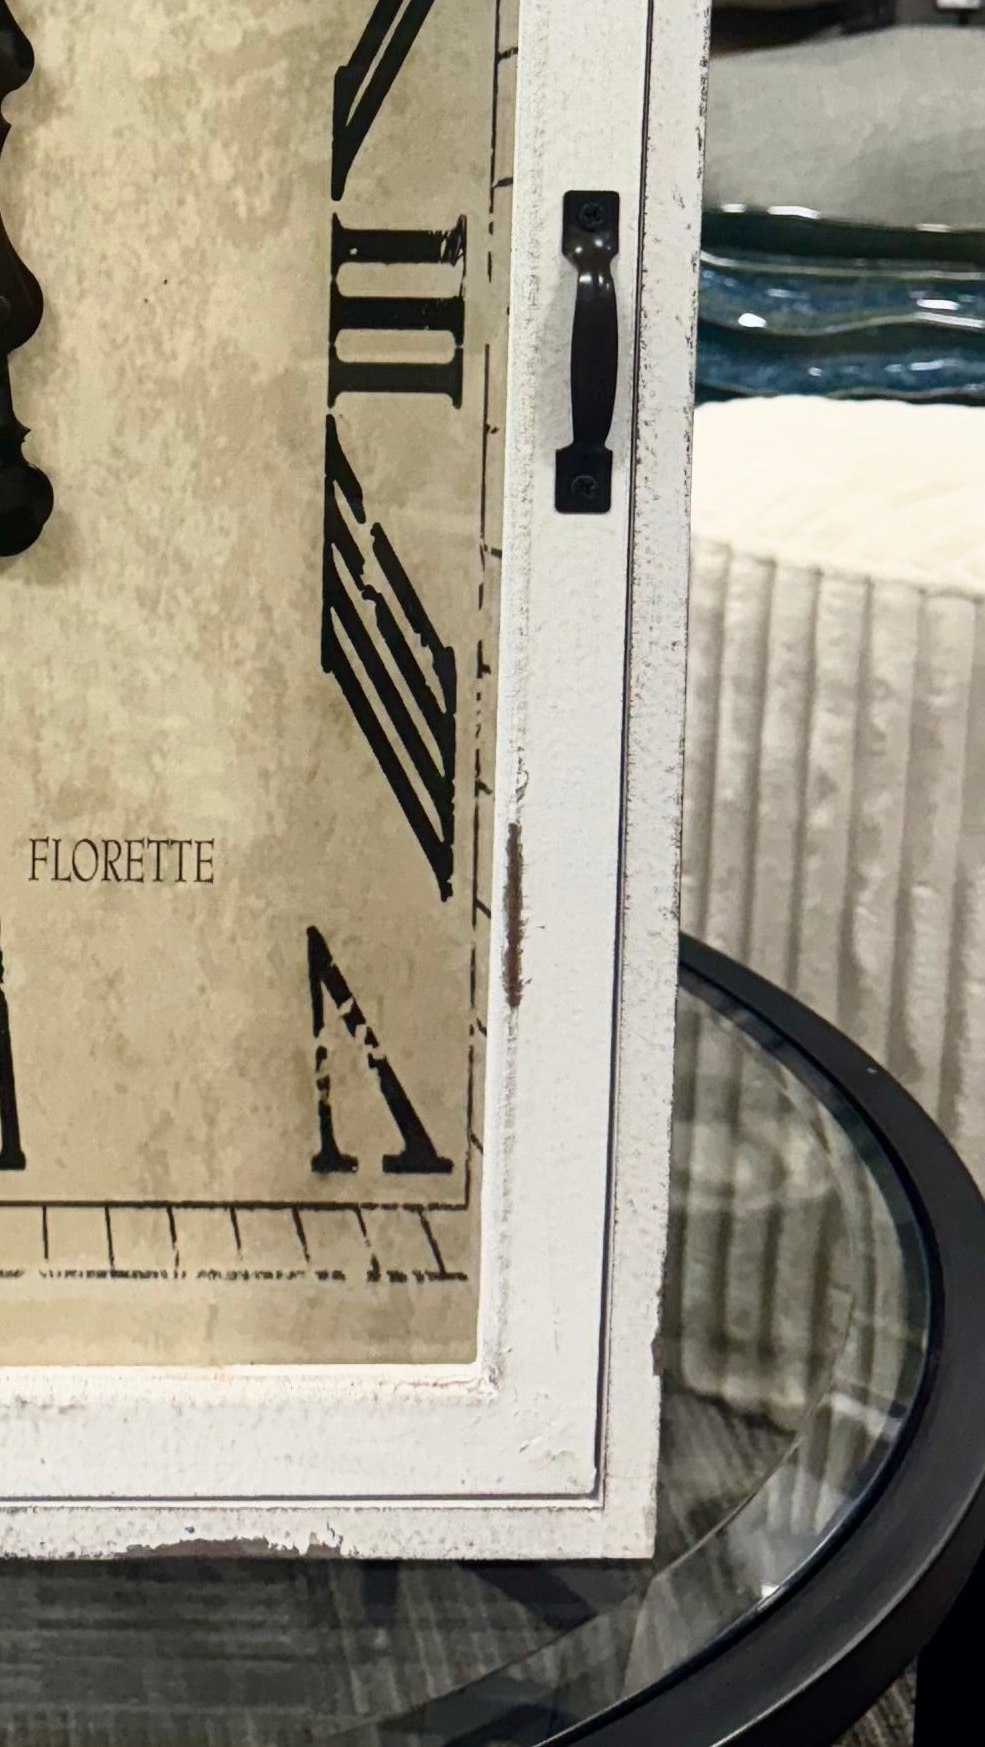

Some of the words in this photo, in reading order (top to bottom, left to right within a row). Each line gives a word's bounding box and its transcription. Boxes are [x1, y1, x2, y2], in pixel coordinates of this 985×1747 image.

[327, 211, 467, 410] III
[28, 836, 215, 883] FLORETTE
[307, 926, 455, 1174] V
